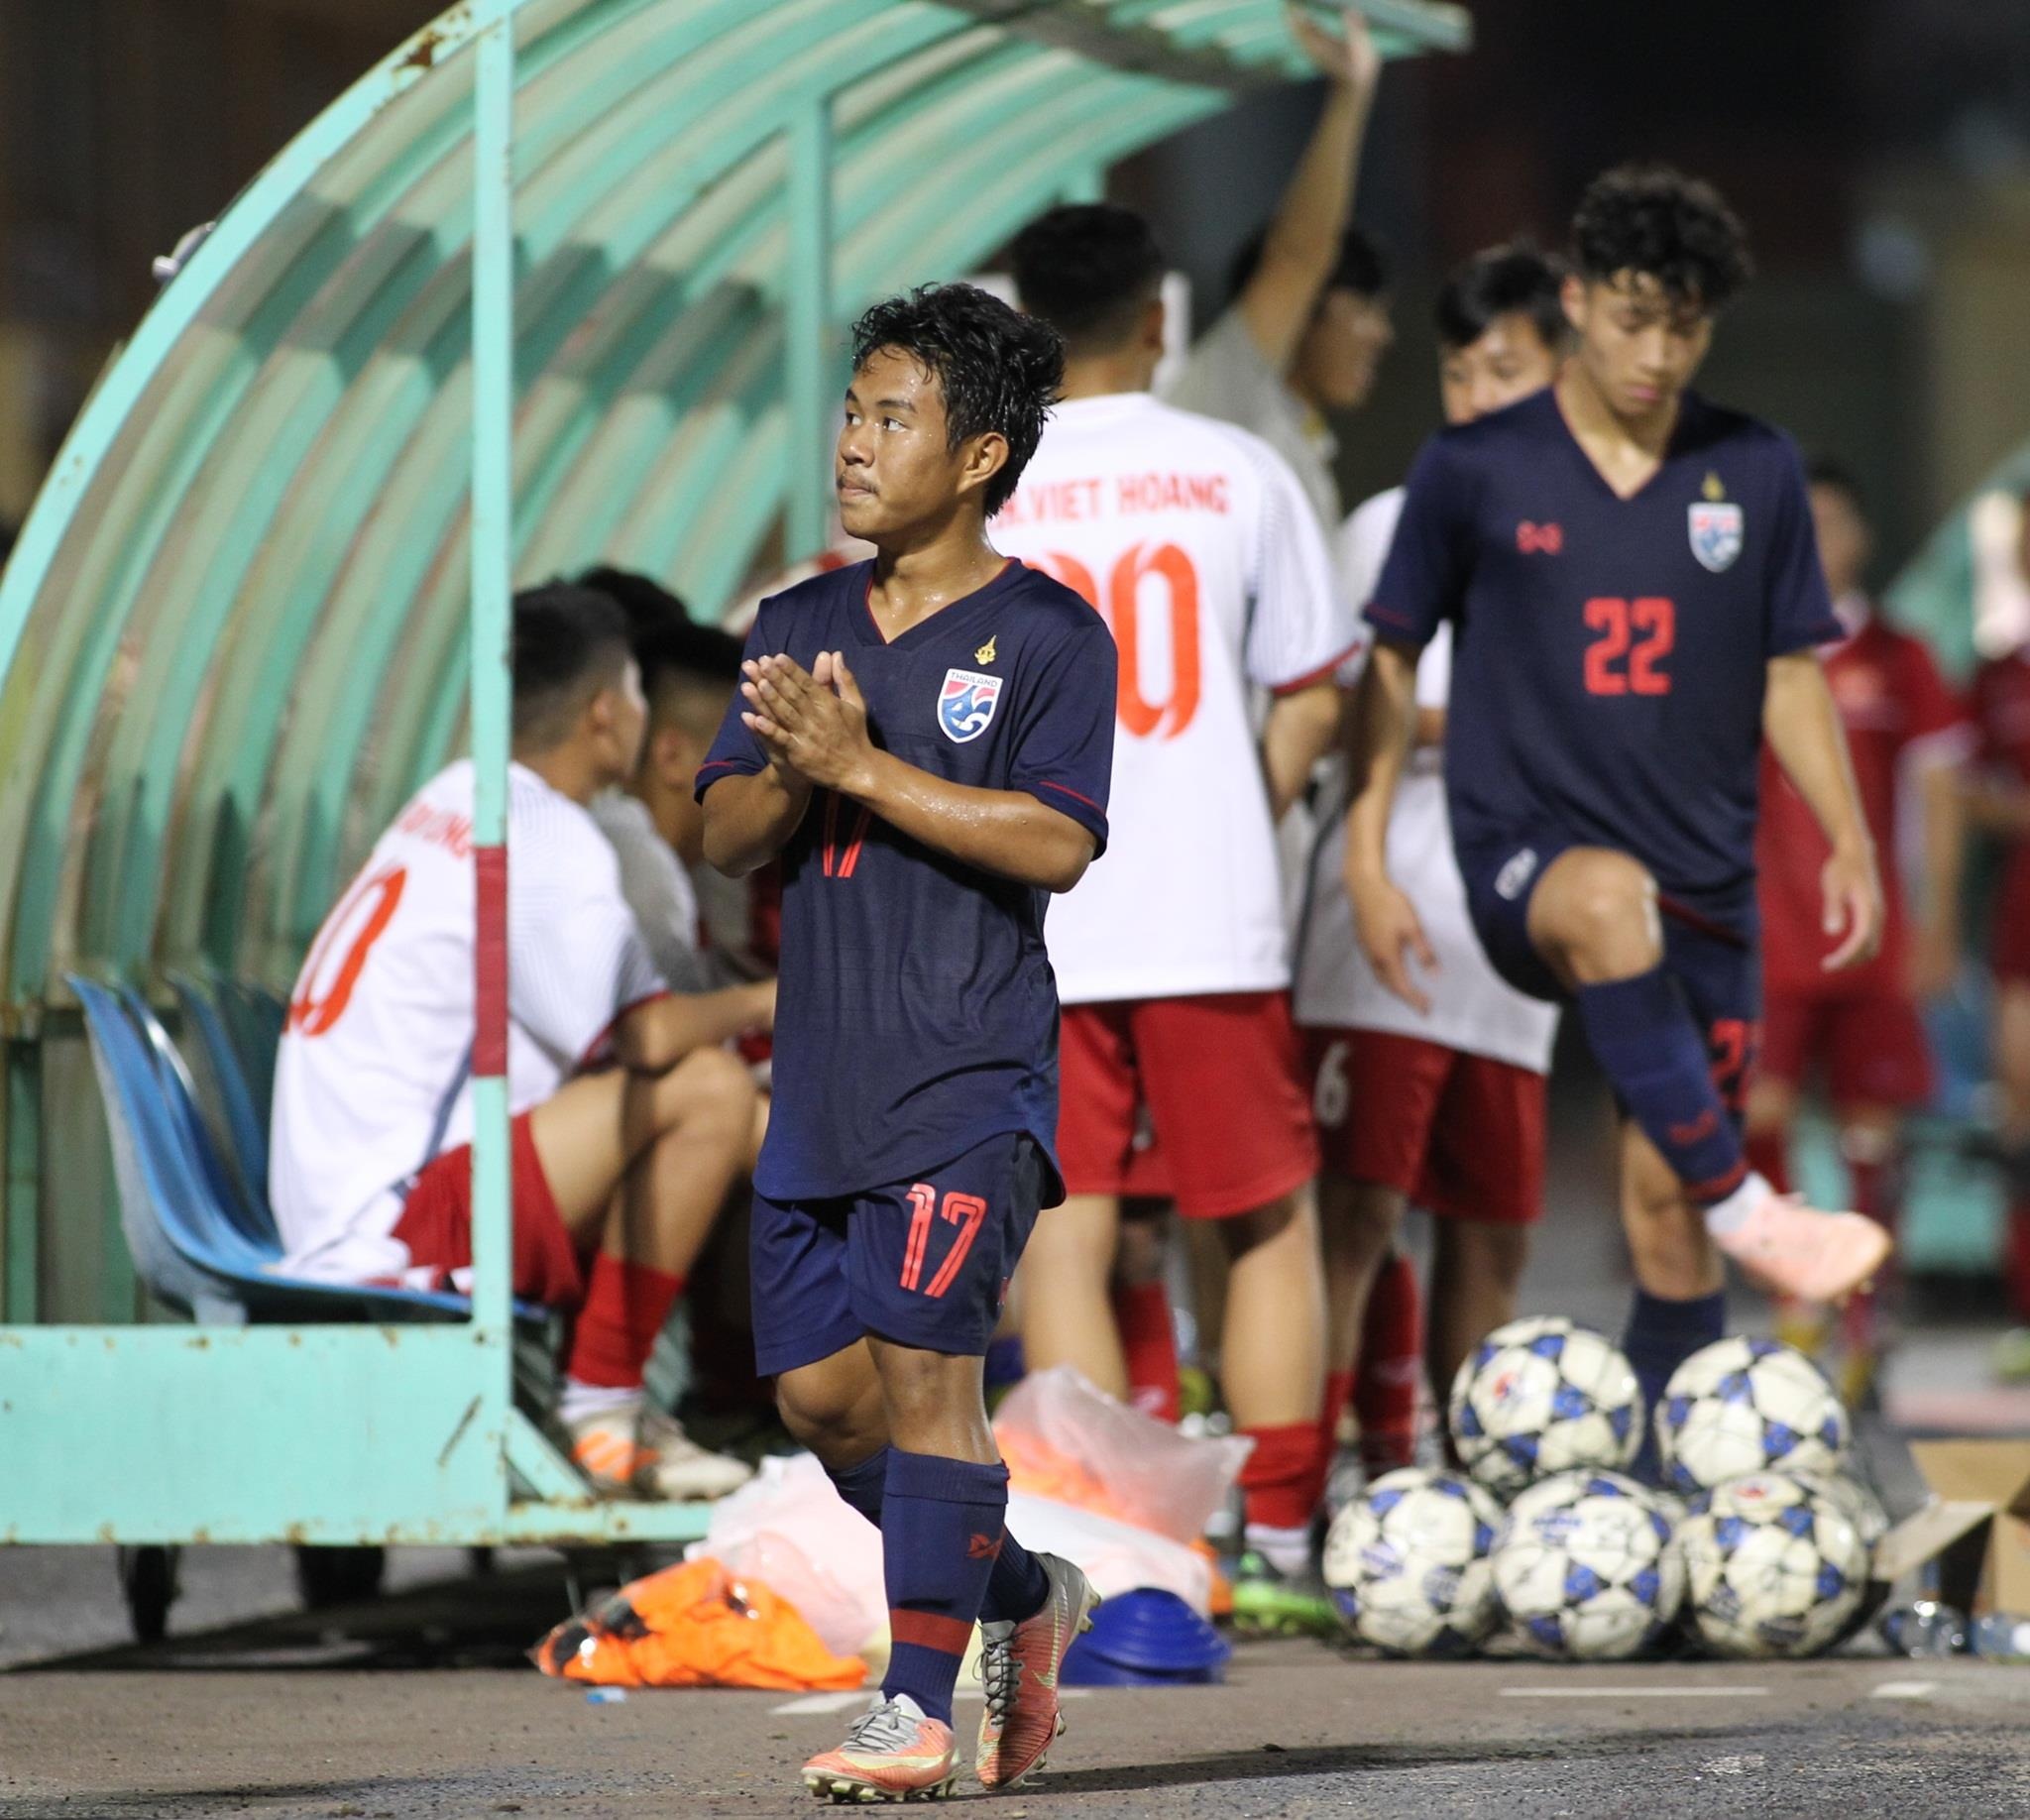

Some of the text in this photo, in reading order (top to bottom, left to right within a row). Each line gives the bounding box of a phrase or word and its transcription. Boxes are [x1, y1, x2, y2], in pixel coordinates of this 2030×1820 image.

[1117, 472, 1229, 516] HOANG
[952, 672, 997, 687] THAILAND
[1585, 598, 1674, 694] 22
[901, 1183, 987, 1299] 17
